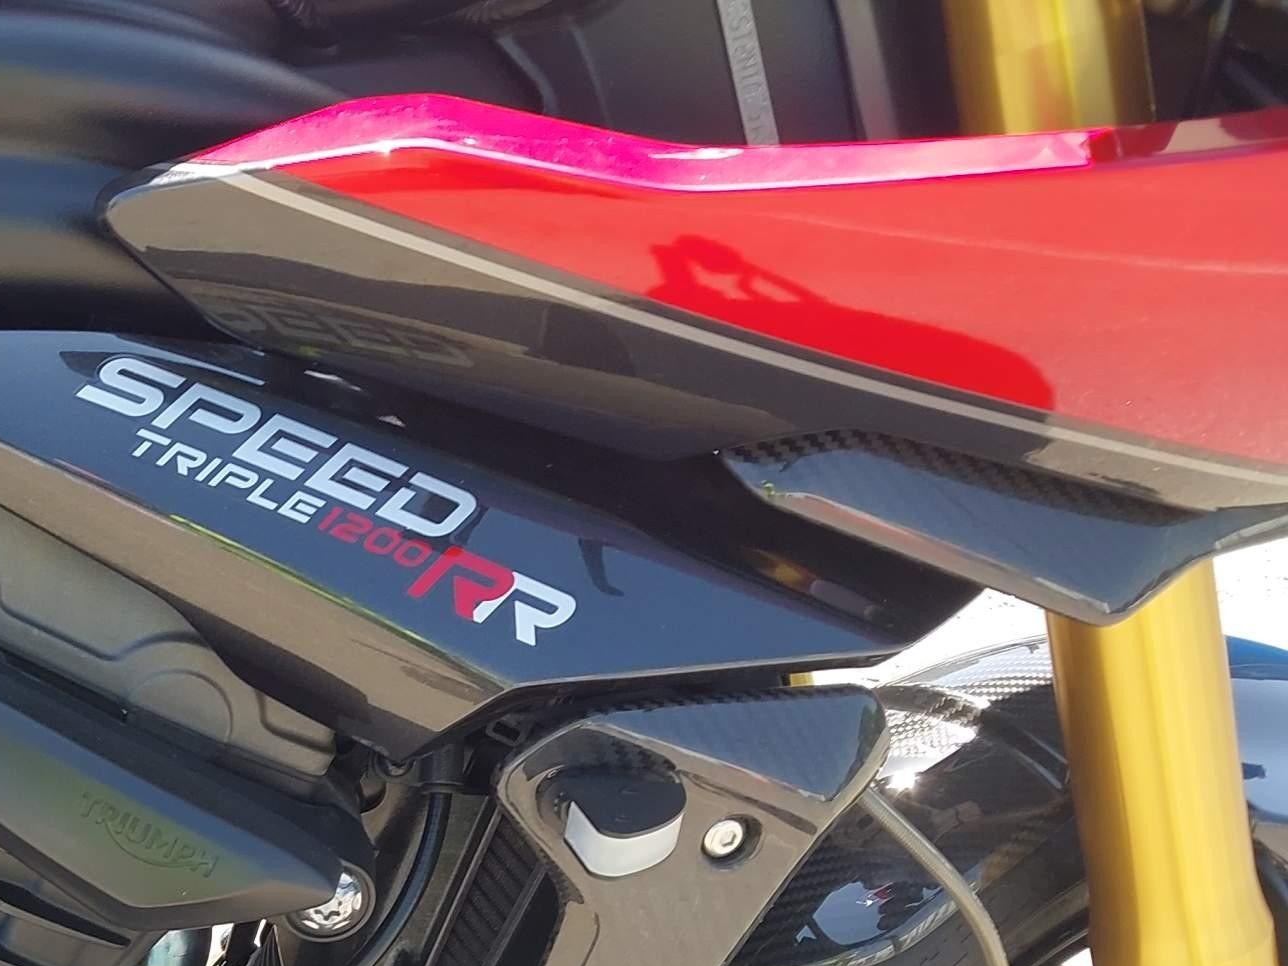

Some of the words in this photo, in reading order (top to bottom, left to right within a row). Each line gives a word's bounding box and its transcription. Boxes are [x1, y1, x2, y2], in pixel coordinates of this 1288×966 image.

[76, 355, 477, 538] SPEED
[131, 428, 325, 523] TRIPLE
[318, 507, 433, 568] 1200
[407, 546, 577, 647] RR
[80, 792, 220, 878] TRIUMPH
